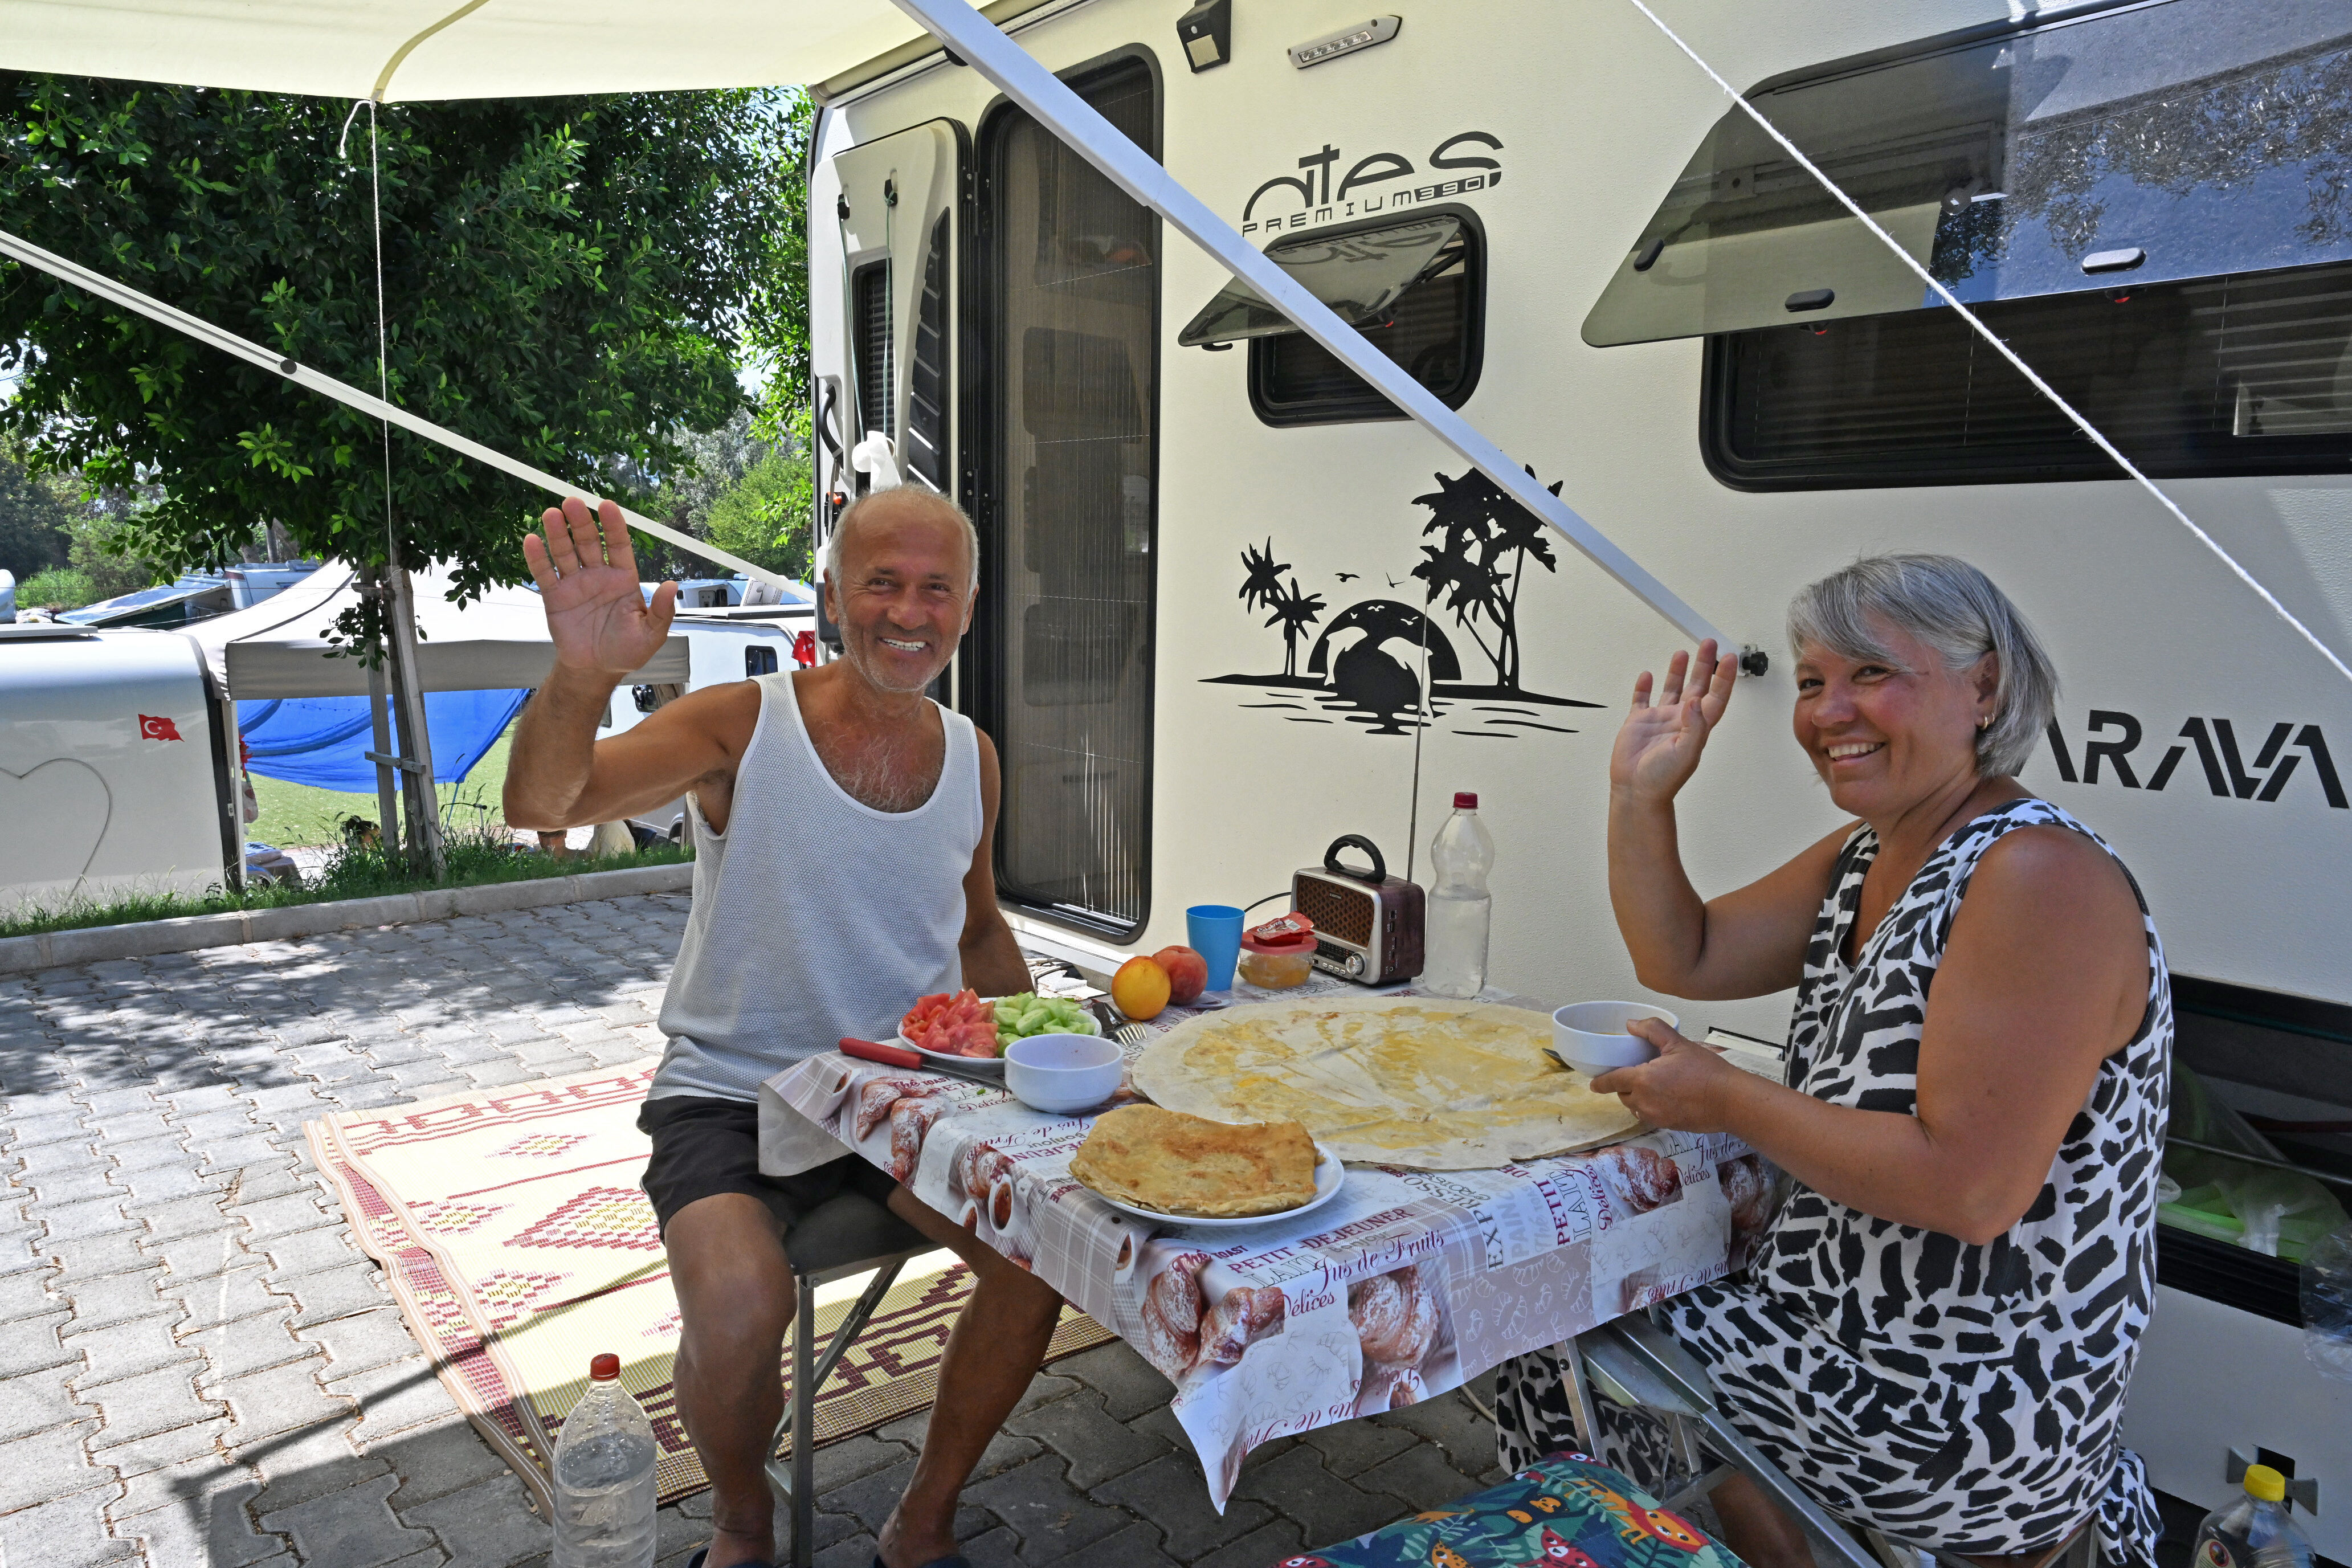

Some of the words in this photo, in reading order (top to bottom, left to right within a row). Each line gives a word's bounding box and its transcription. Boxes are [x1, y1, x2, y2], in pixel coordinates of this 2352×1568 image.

[1242, 190, 1412, 237] PREMIUM
[1418, 175, 1483, 200] 390
[2012, 709, 2350, 809] ARAVA
[920, 1076, 952, 1086] TOAST
[1050, 1183, 1084, 1204] SUCRE
[1532, 1178, 1571, 1247] PETIT
[1211, 1245, 1249, 1259] TOAST
[1226, 1246, 1296, 1275] PETIT
[1309, 1253, 1353, 1297] Jus
[1357, 1248, 1379, 1273] de
